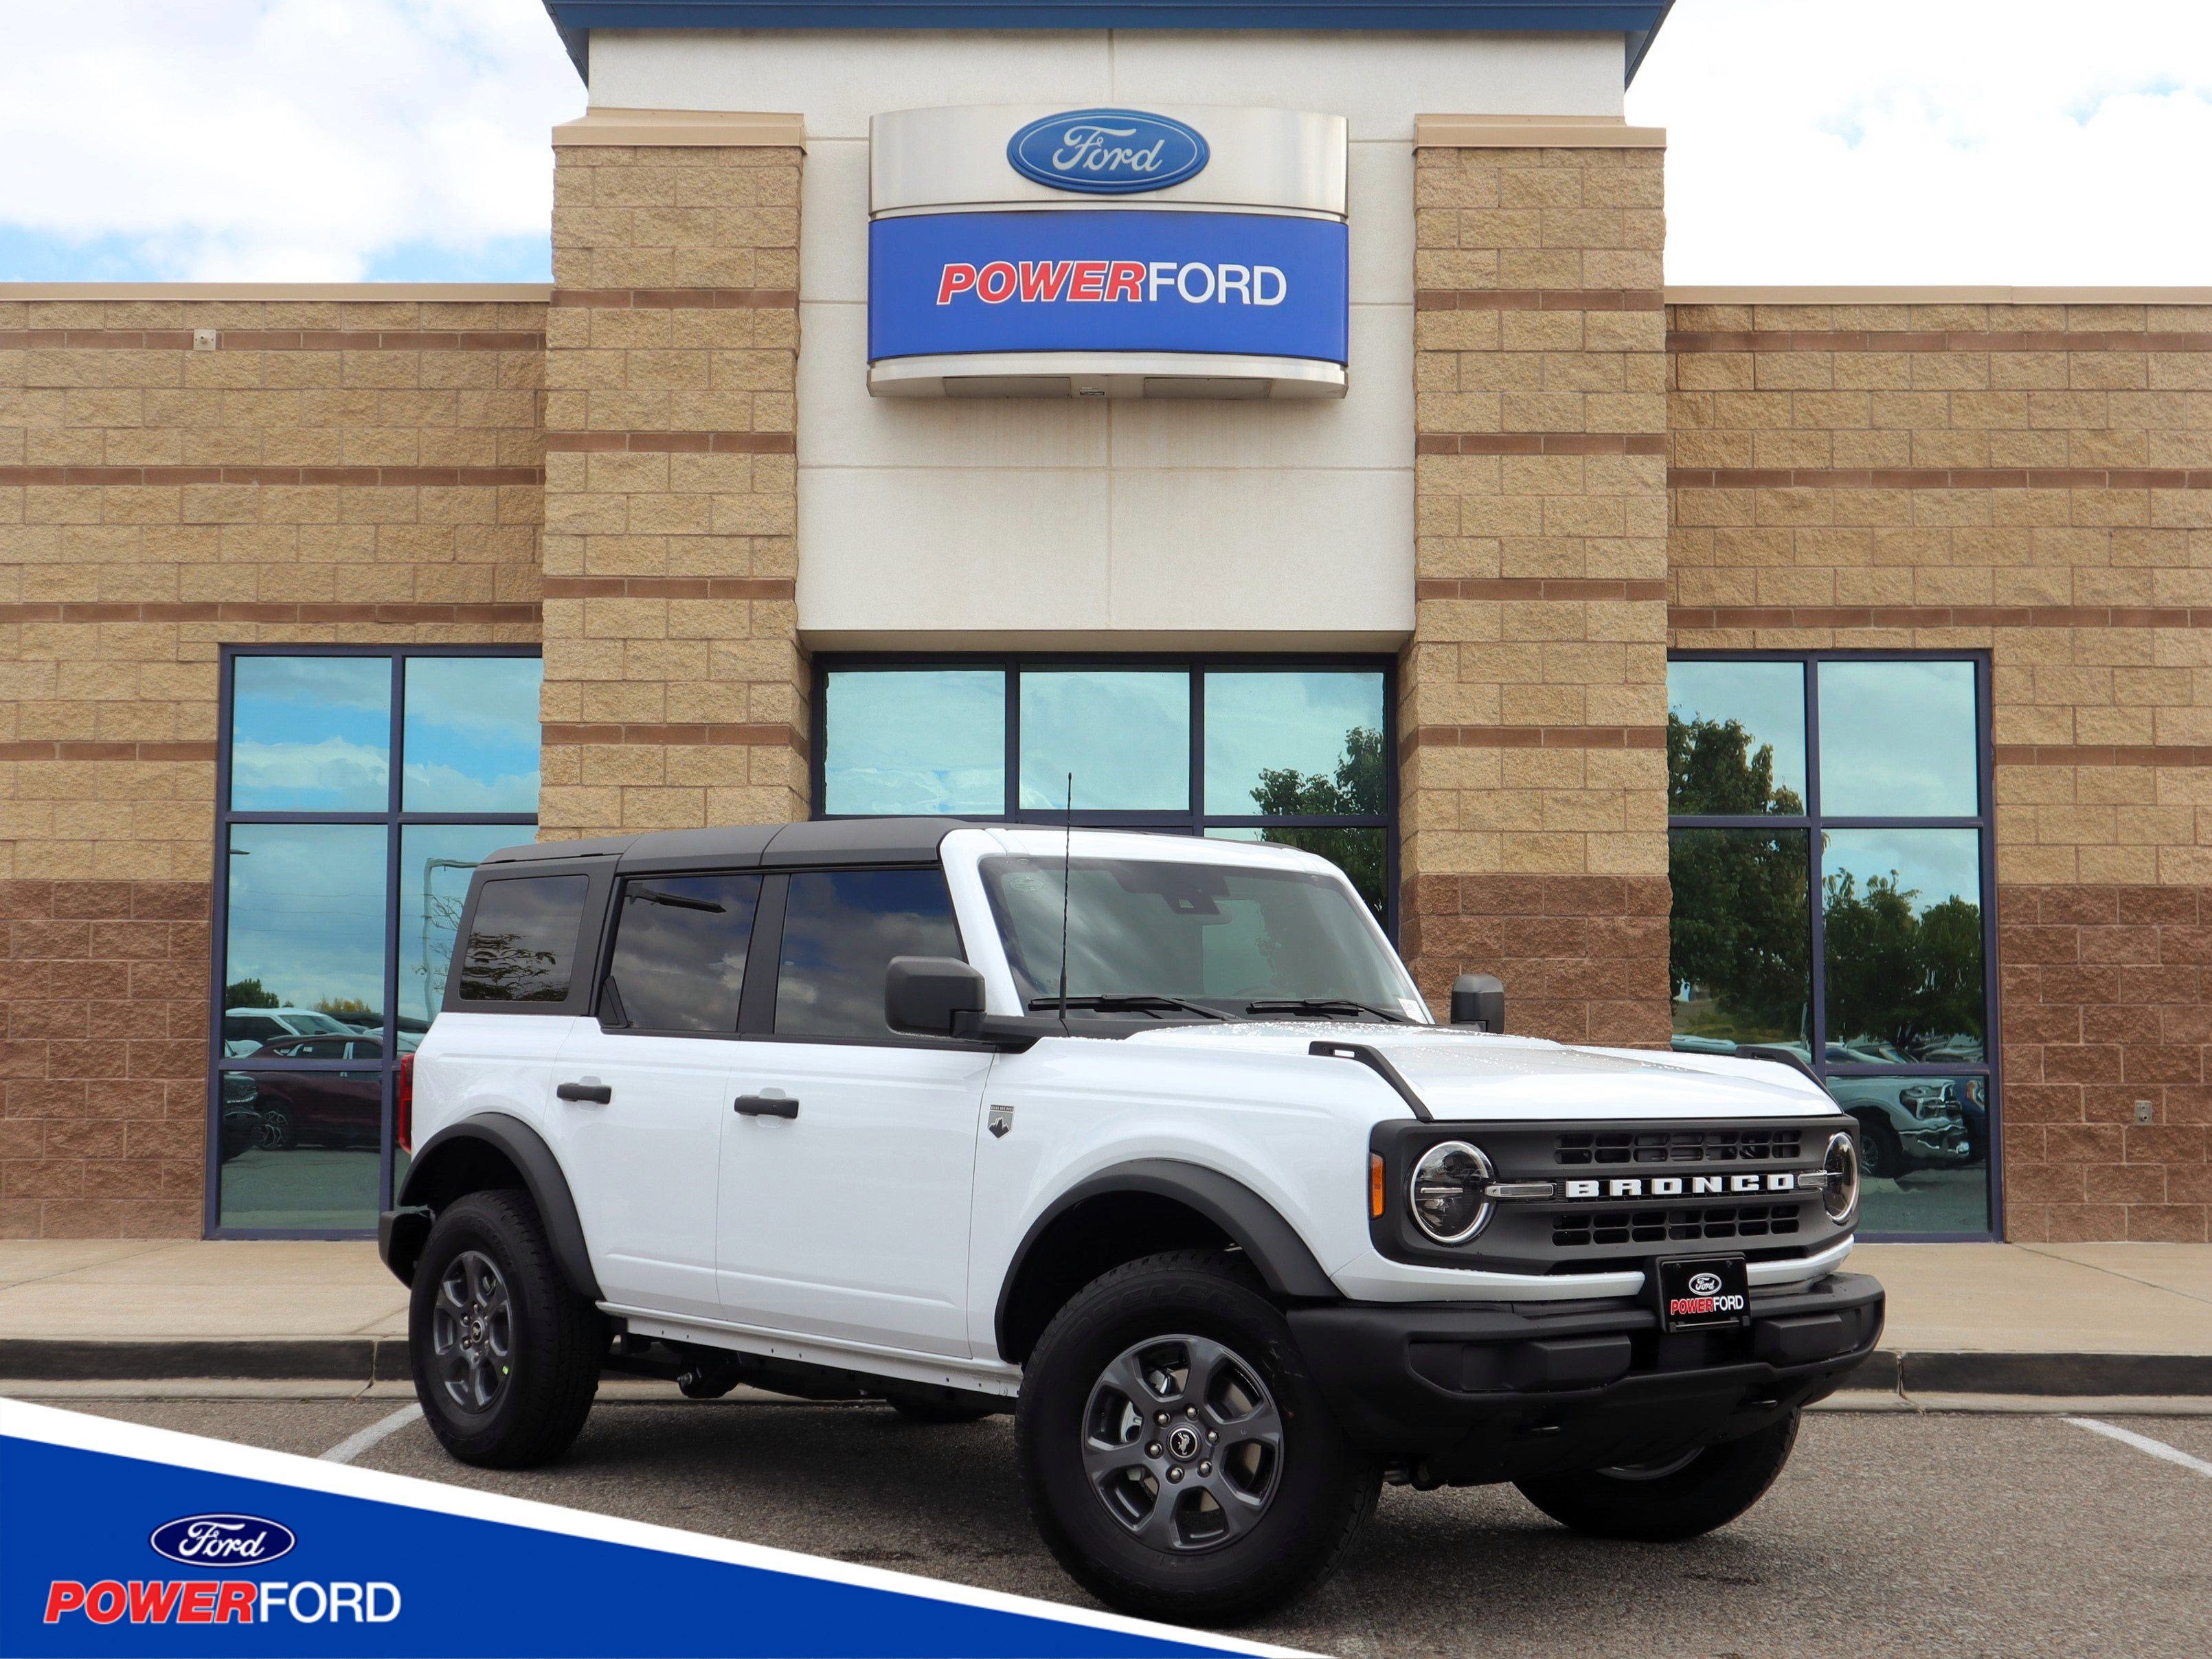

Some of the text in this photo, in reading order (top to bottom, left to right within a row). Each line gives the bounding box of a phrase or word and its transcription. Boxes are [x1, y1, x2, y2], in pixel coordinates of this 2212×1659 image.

[1052, 126, 1165, 172] Ford
[1566, 1174, 1794, 1197] BRONCO
[1695, 1277, 1715, 1291] Ford
